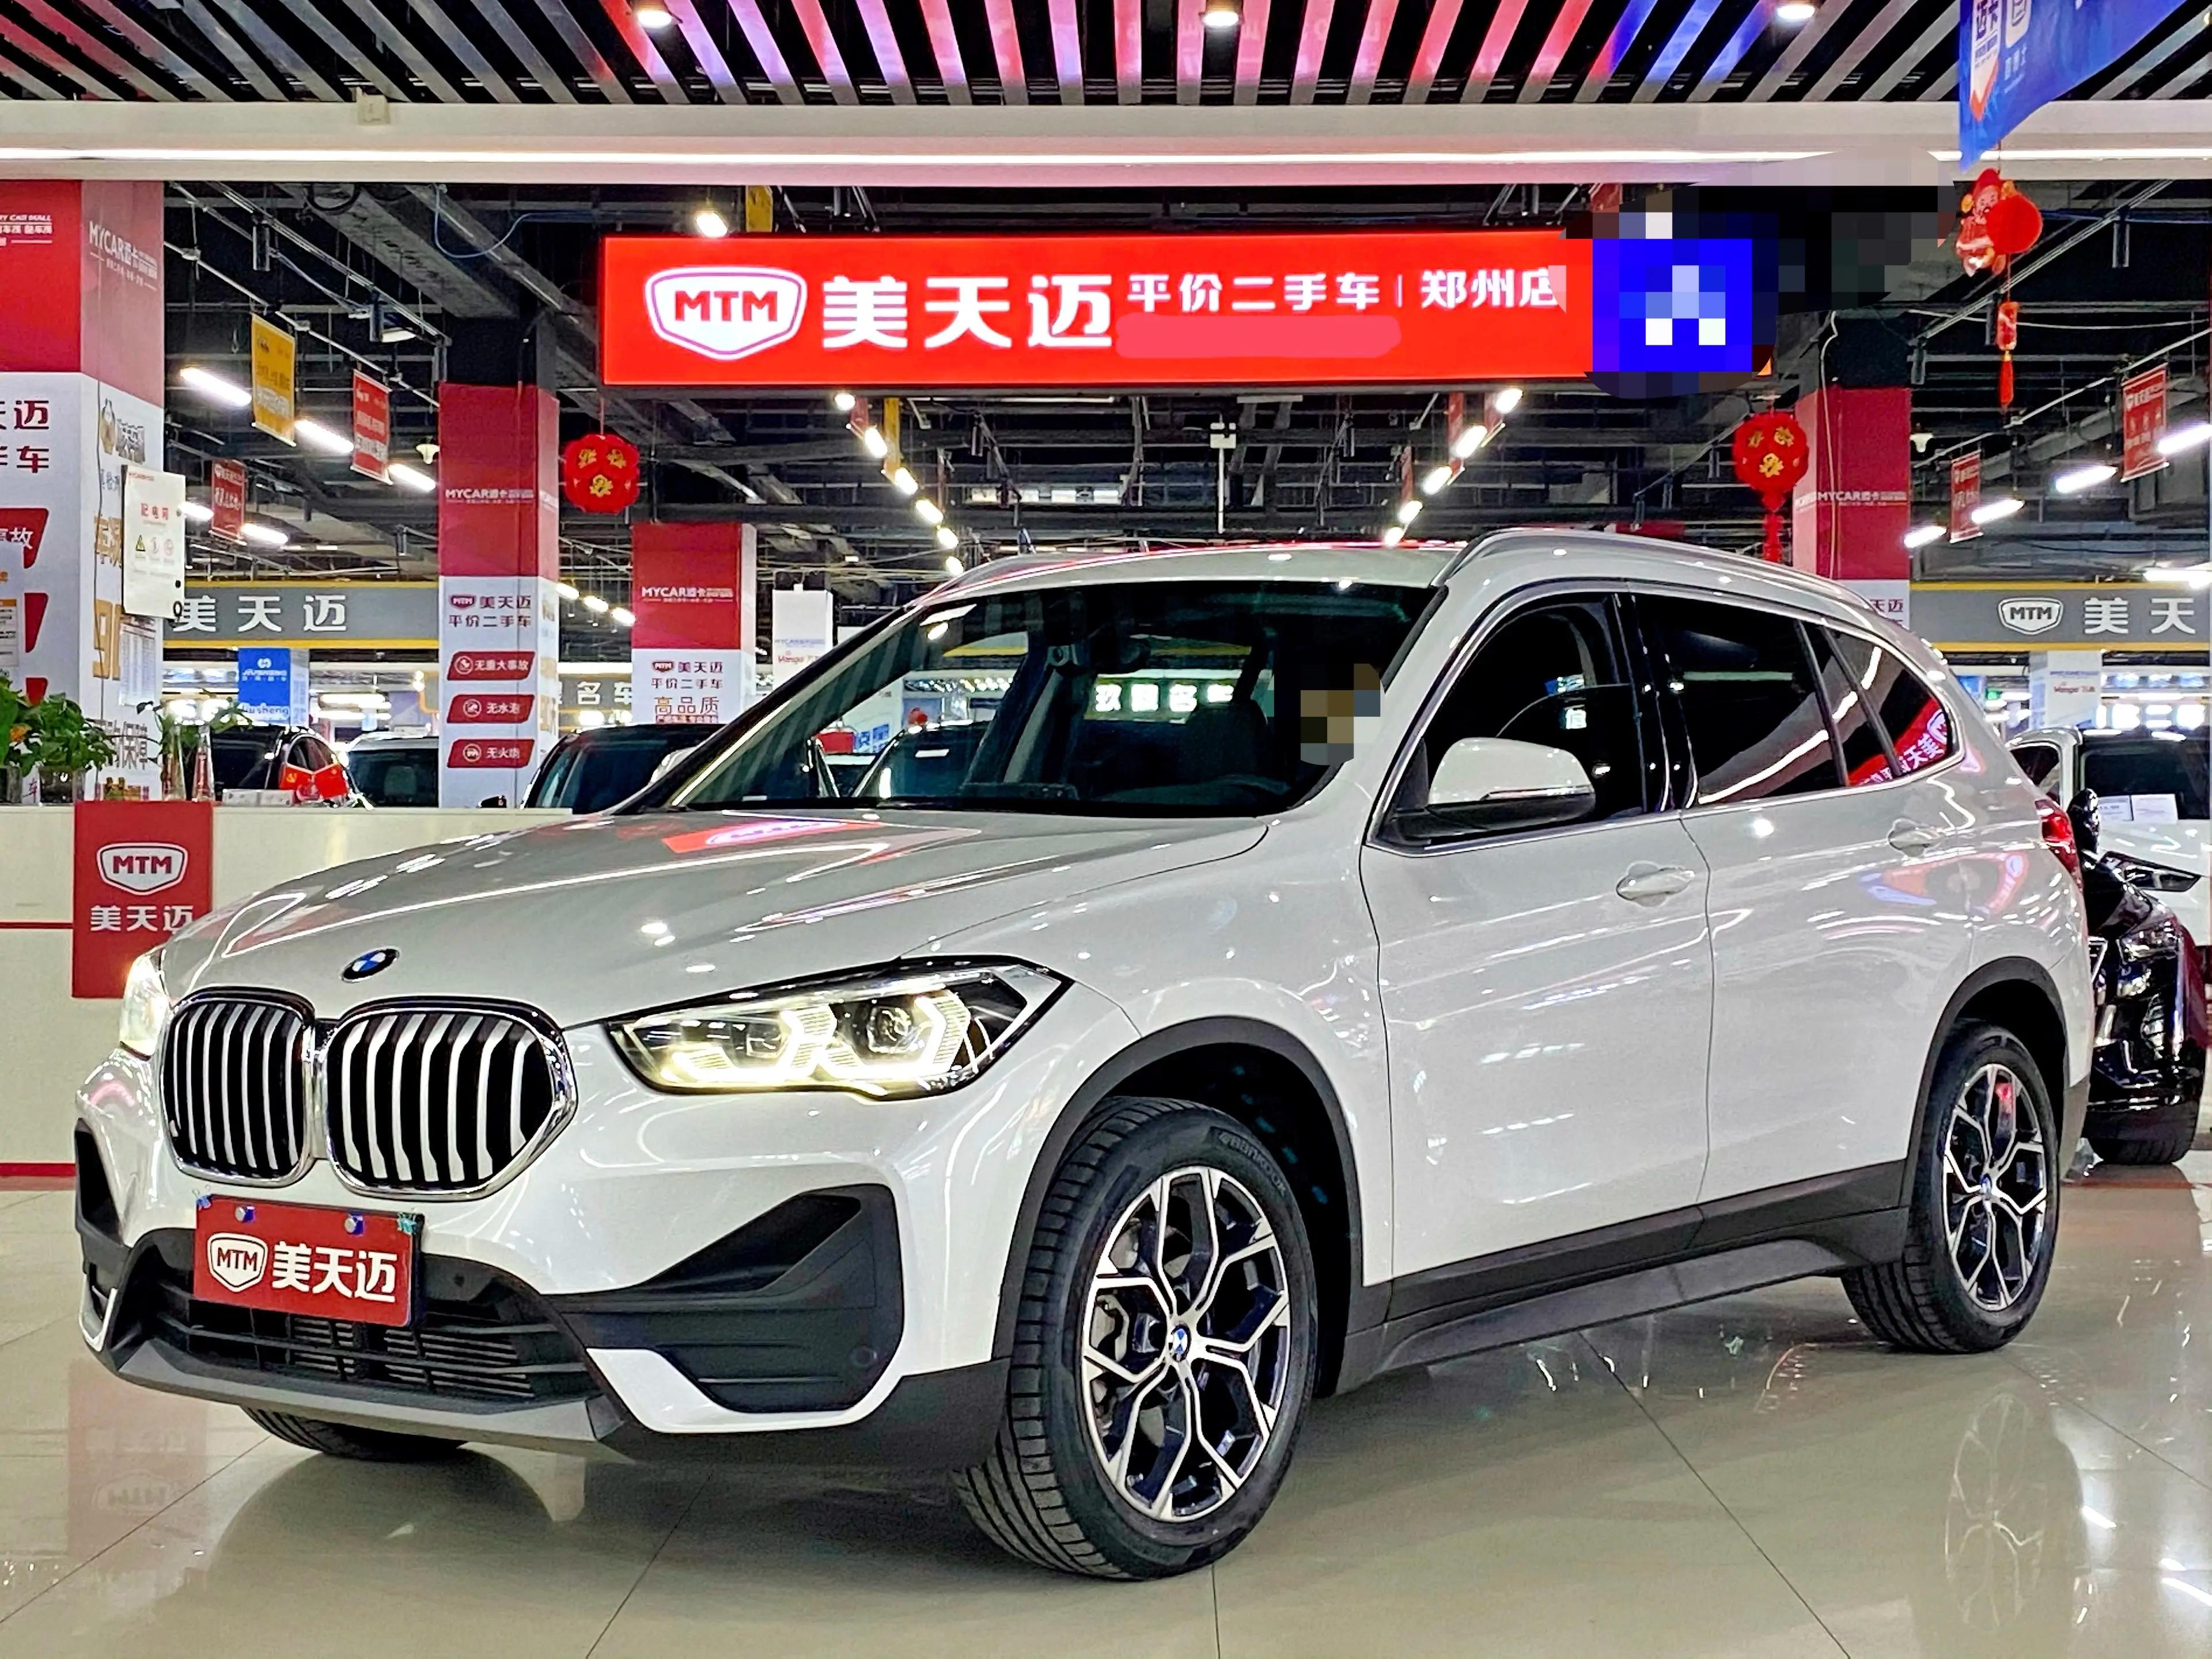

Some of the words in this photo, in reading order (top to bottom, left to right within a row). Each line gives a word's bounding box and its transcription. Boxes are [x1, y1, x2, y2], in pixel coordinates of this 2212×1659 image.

[1127, 272, 1380, 312] 平价二手车
[1421, 268, 1561, 309] 郑州店
[675, 290, 778, 321] MTM
[822, 274, 1112, 349] 美天迈
[0, 400, 49, 430] 迈
[0, 446, 49, 473] 车
[174, 594, 347, 632] 美天迈
[480, 595, 531, 609] 美天迈
[2010, 607, 2052, 620] MTM
[2084, 597, 2196, 634] 美天
[449, 615, 531, 628] 平价二手车
[677, 661, 723, 673] 美天迈
[559, 681, 632, 704] 名车
[651, 677, 723, 690] 平价二手车
[654, 696, 719, 715] 高品质
[112, 855, 172, 874] MTM
[90, 905, 194, 933] 美天迈
[217, 1247, 257, 1272] MTM
[271, 1240, 397, 1303] 美天迈
